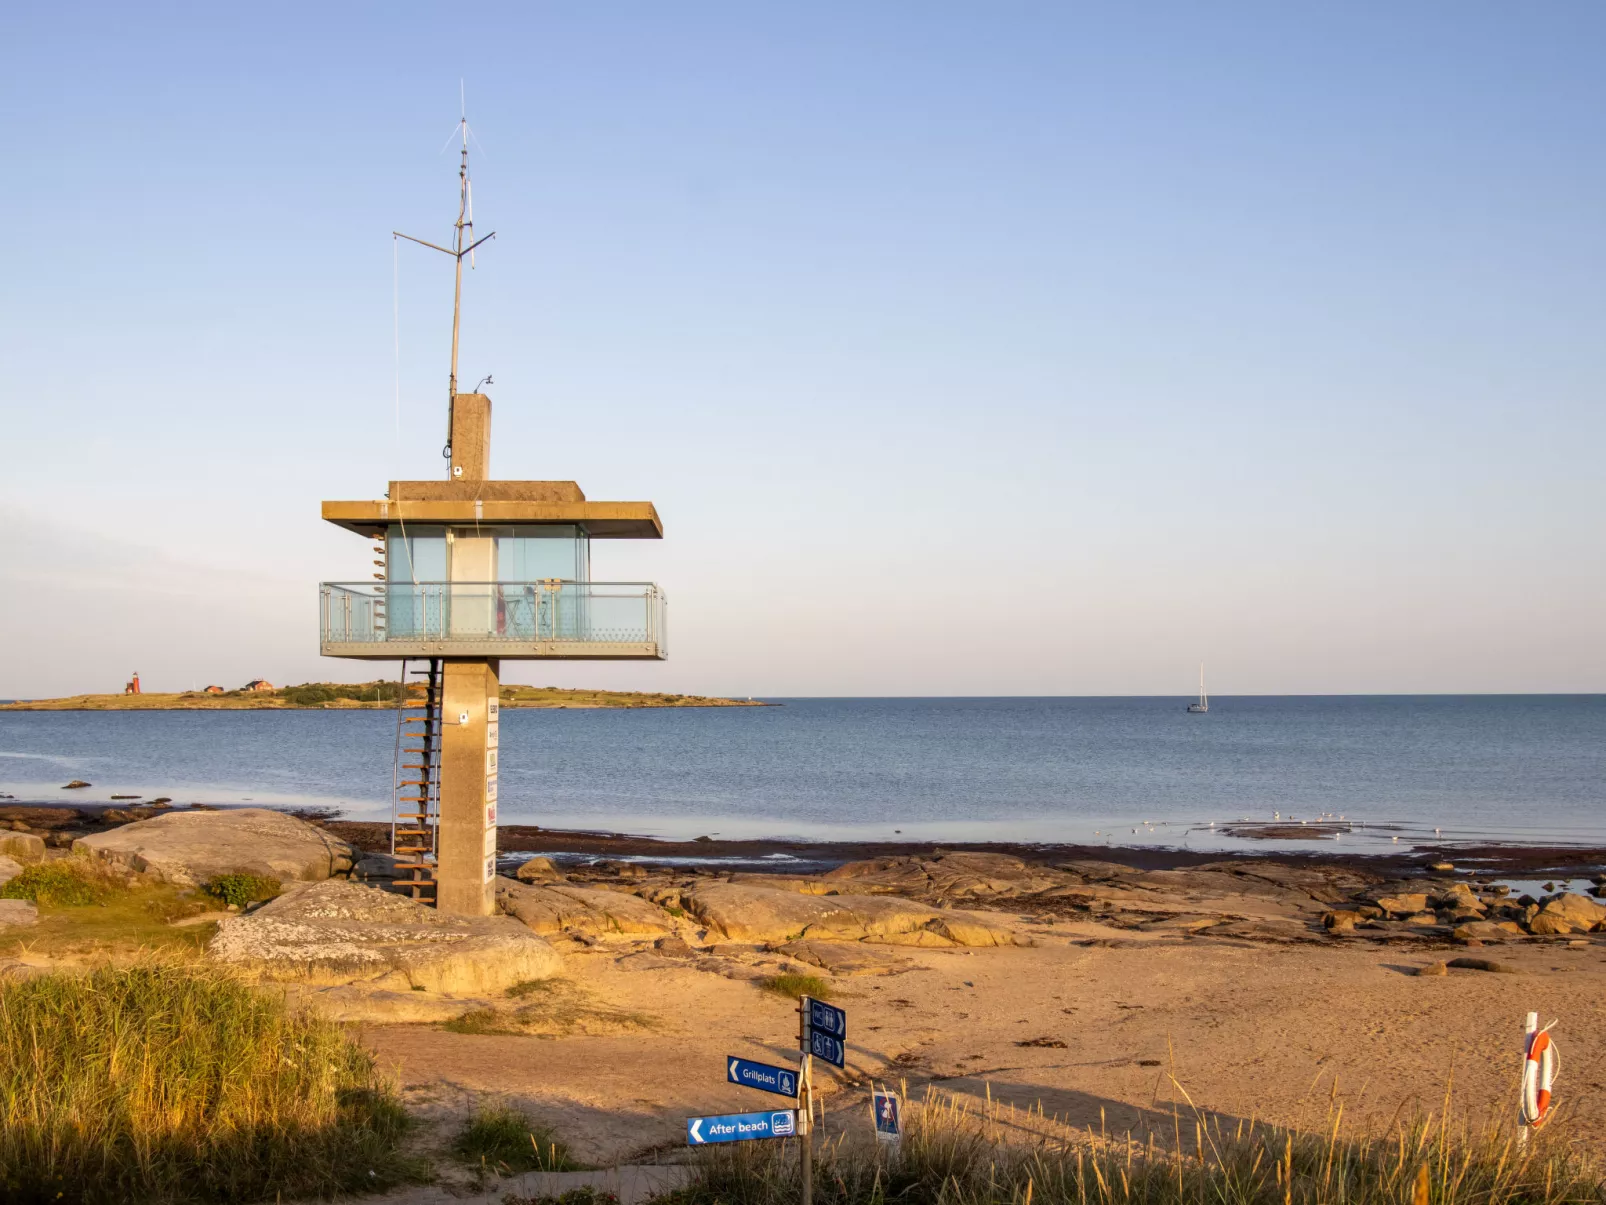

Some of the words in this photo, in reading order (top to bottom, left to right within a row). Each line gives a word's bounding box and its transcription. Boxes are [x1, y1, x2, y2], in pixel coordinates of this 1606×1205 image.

[814, 1010, 822, 1019] WC
[743, 1068, 775, 1084] Grillplats
[709, 1123, 735, 1135] After
[738, 1121, 768, 1133] beach
